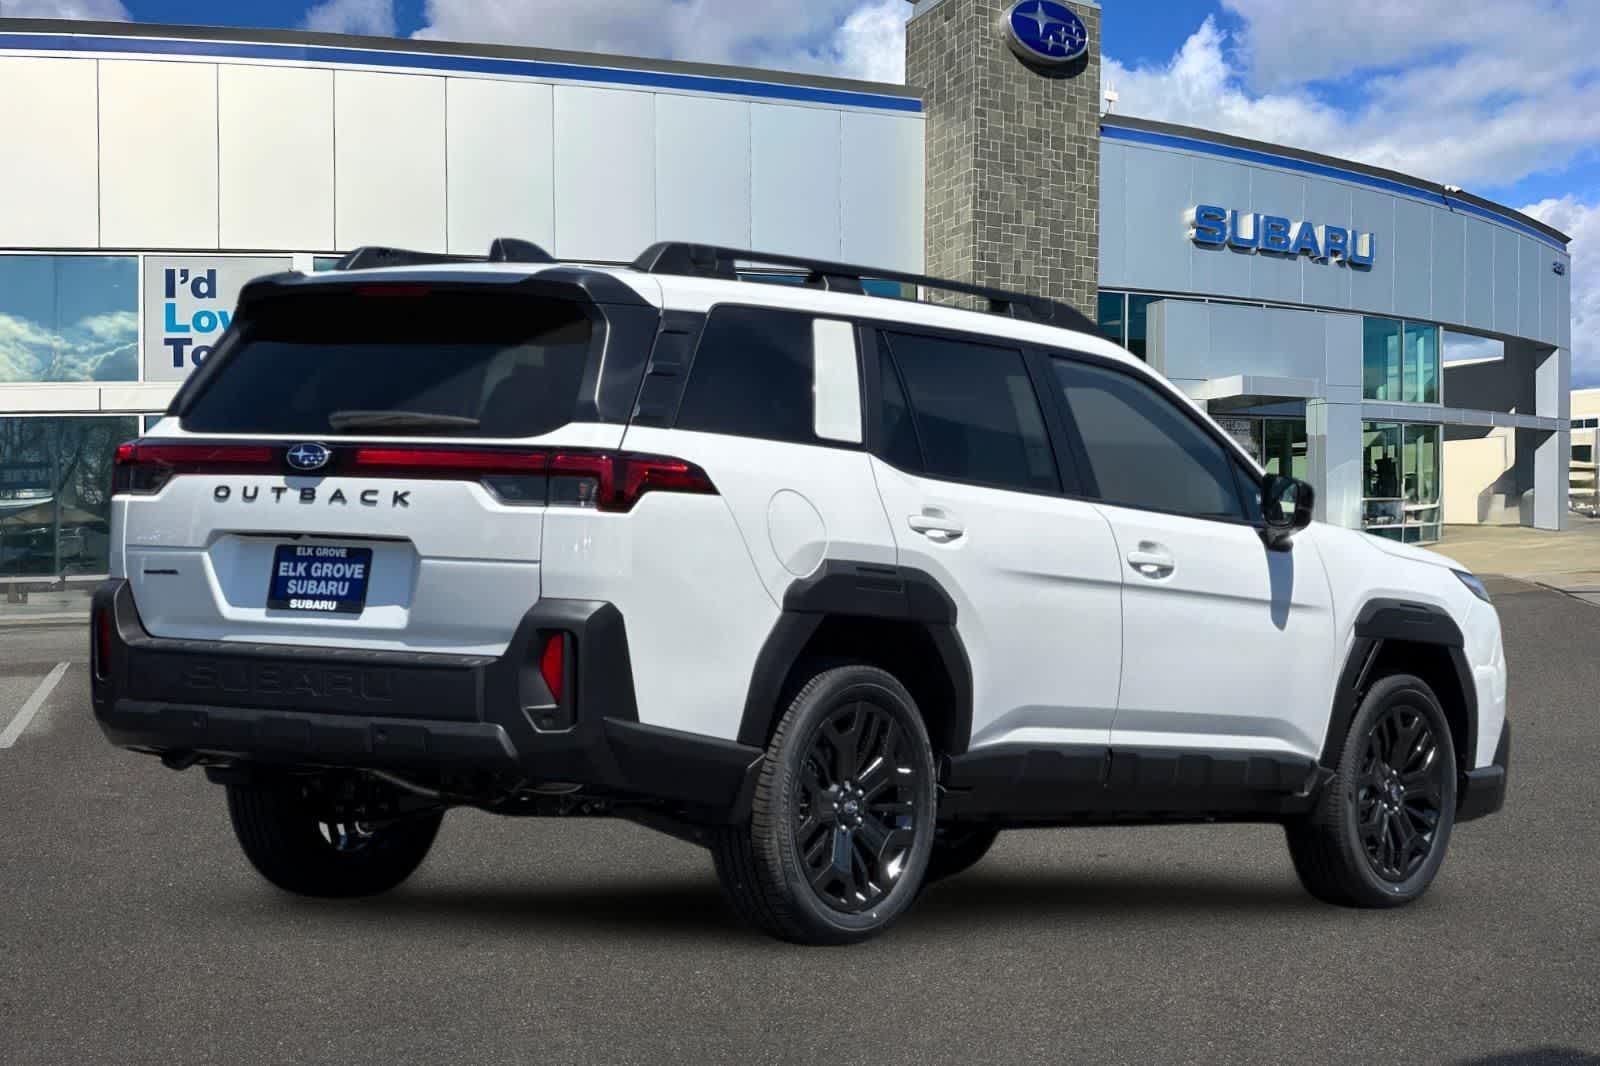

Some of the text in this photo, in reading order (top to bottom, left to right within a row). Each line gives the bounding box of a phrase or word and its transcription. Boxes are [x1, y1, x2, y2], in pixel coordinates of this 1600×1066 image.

[1190, 204, 1377, 268] SUBARU
[165, 268, 217, 299] I'd
[213, 485, 411, 507] OUTBACK
[296, 546, 348, 558] ELK GROVE
[279, 561, 365, 579] ELK GROVE
[286, 580, 350, 596] SUBARU
[289, 599, 337, 611] SUBARU
